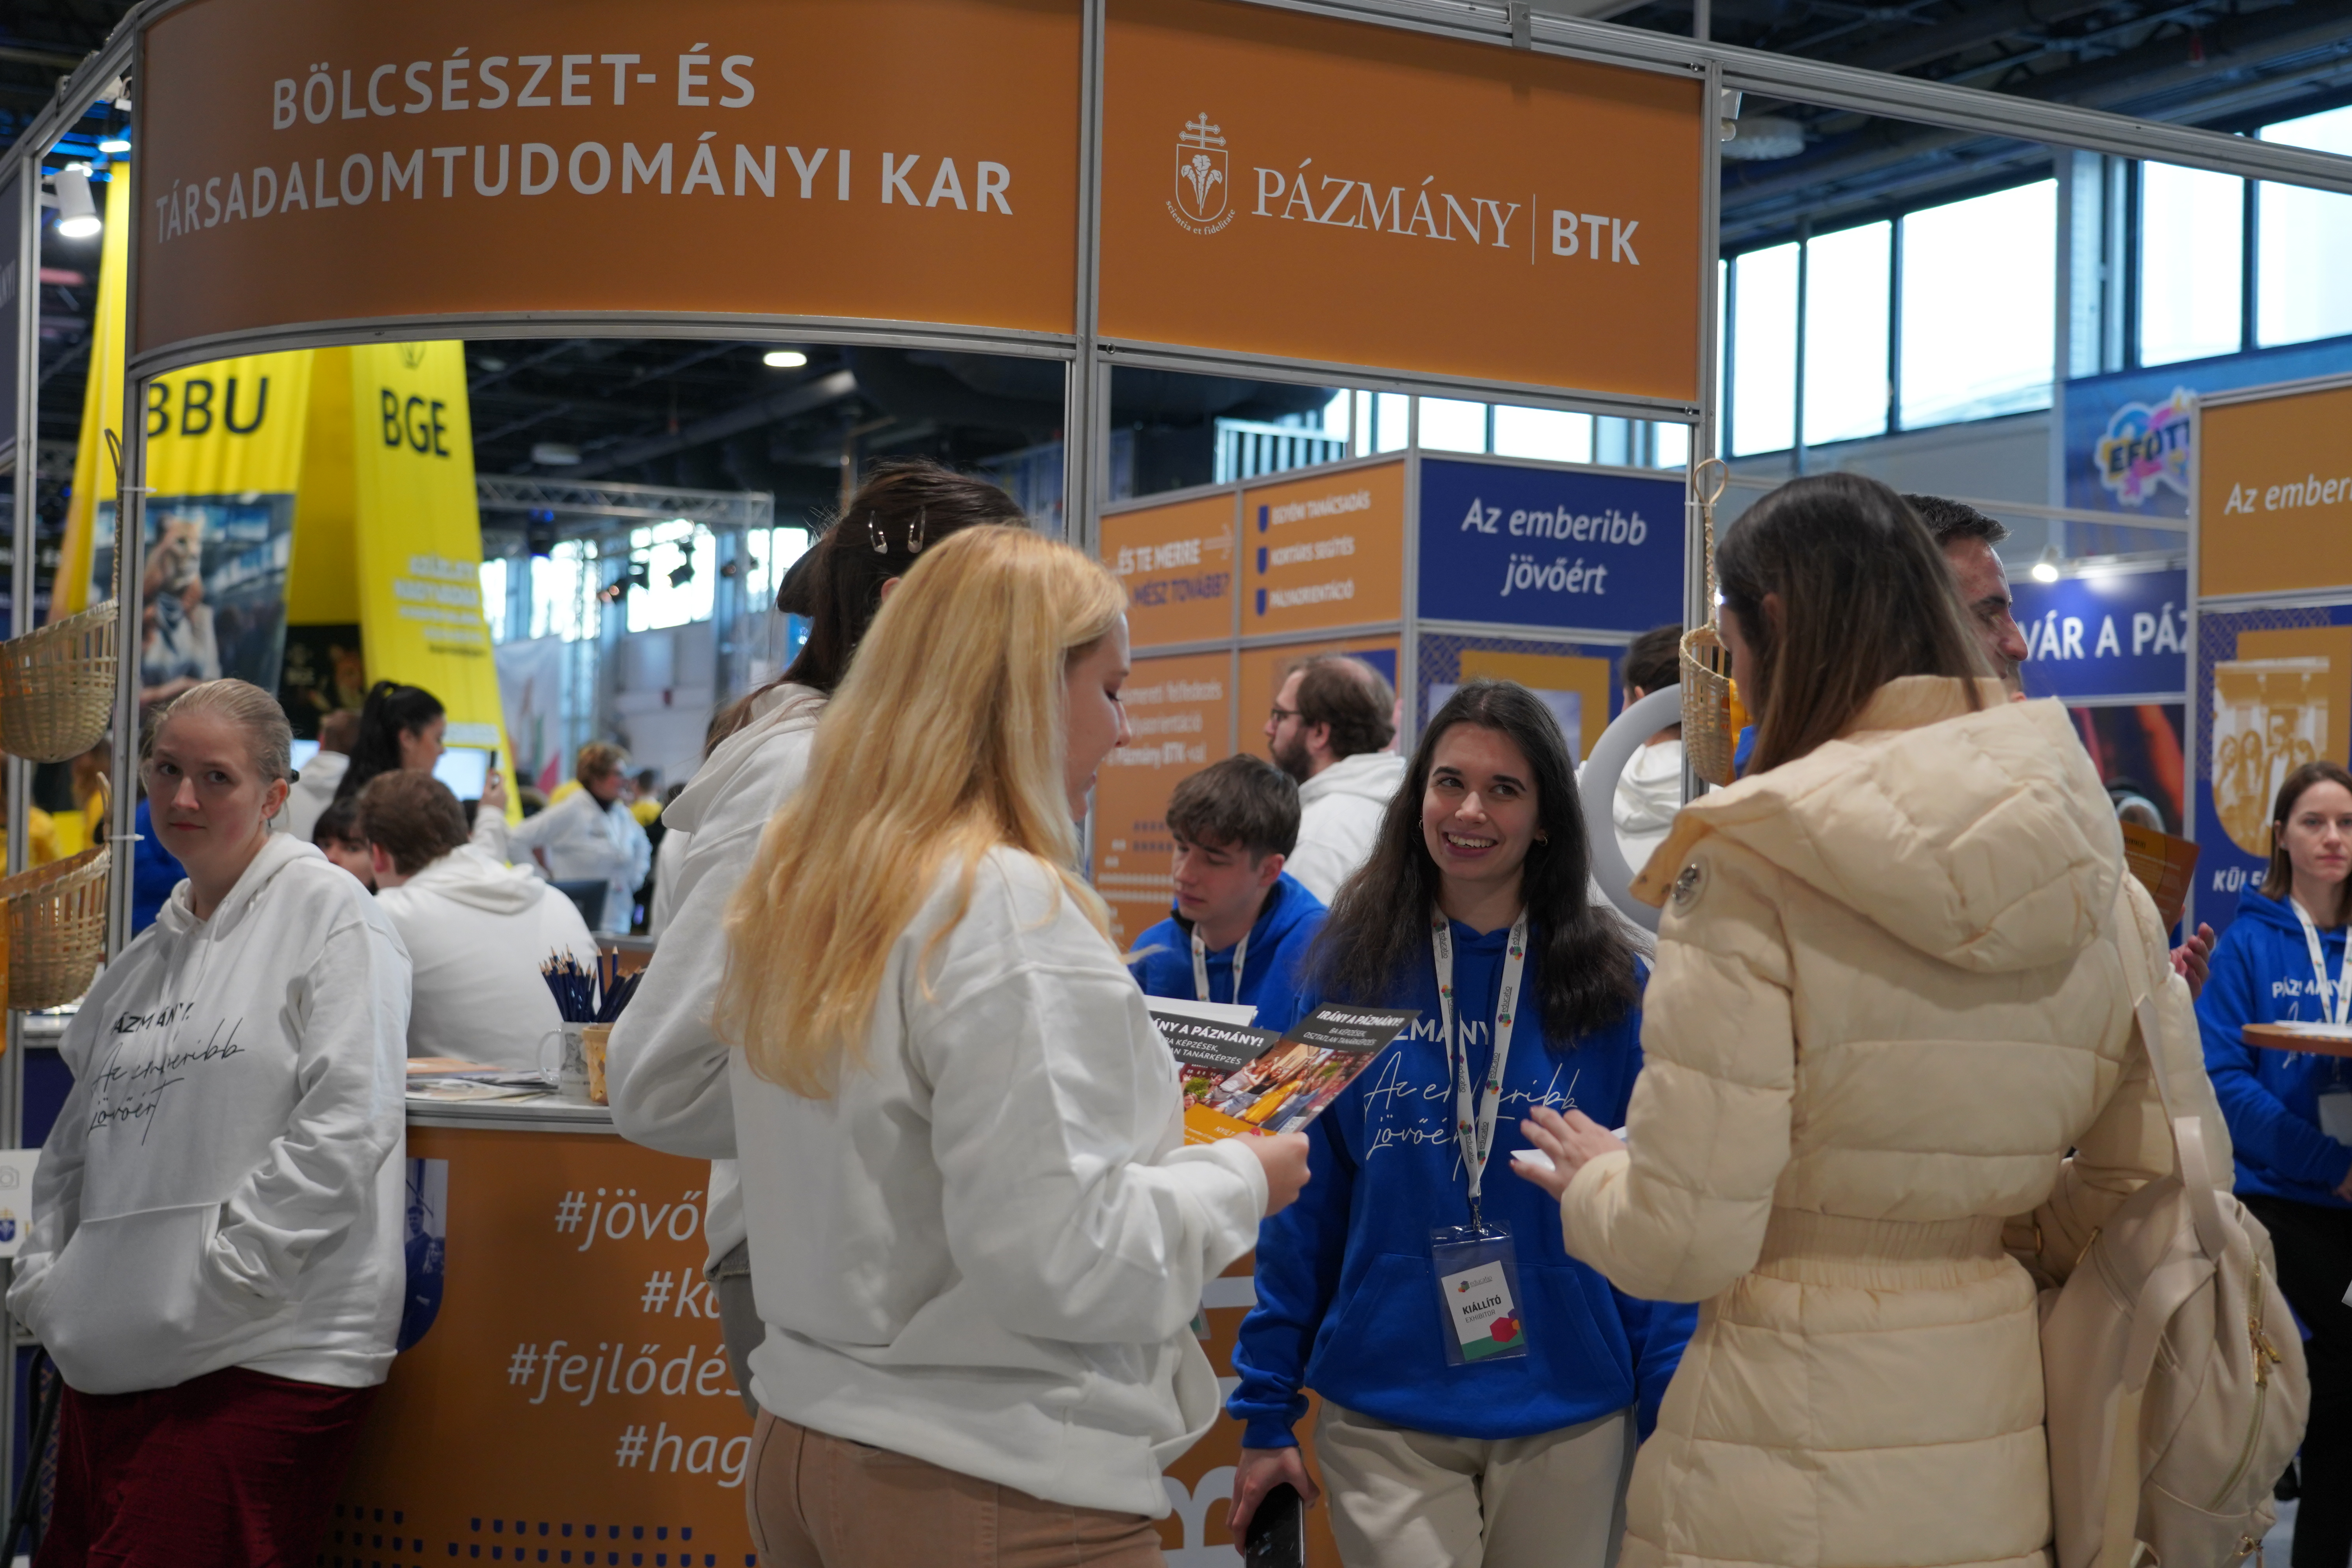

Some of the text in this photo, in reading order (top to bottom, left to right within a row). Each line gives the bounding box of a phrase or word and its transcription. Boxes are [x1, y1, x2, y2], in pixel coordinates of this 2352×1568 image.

[272, 42, 755, 130] BÖLCSÉSZET- ÉS
[155, 131, 1014, 244] TÁRSADALOMTUDOMÁNYI KAR
[1166, 201, 1191, 231] scientia
[1204, 209, 1235, 235] fidelitate
[1251, 158, 1641, 266] PÁZMÁNY BTK
[147, 377, 268, 439] BBU
[381, 388, 450, 458] BGE
[2224, 482, 2258, 515] Az
[1461, 497, 1647, 546] Az emberibb
[1500, 553, 1608, 597] jövőért
[2018, 610, 2085, 662] VÁR
[2094, 614, 2121, 659] A
[1439, 932, 1448, 959] educatio
[1502, 986, 1512, 1013] educatio
[1153, 1018, 1265, 1047] ÁNY A PÁZMÁNY!
[1316, 1010, 1405, 1026] IRÁNY A PÁZMÁNY!
[1175, 1038, 1219, 1053] KÉPZÉSEK,
[1303, 1032, 1337, 1043] OSZTATLAN
[1183, 1048, 1242, 1065] TANÁRKÉPZÉS
[1489, 1052, 1501, 1079] educatio
[1364, 1051, 1417, 1123] Az
[1465, 1135, 1474, 1164] educatio
[1479, 1121, 1489, 1149] educatio
[1470, 1275, 1493, 1287] educatio
[1462, 1294, 1502, 1315] KIÁLLÍTÓ
[1465, 1309, 1496, 1323] EXHIBITOR
